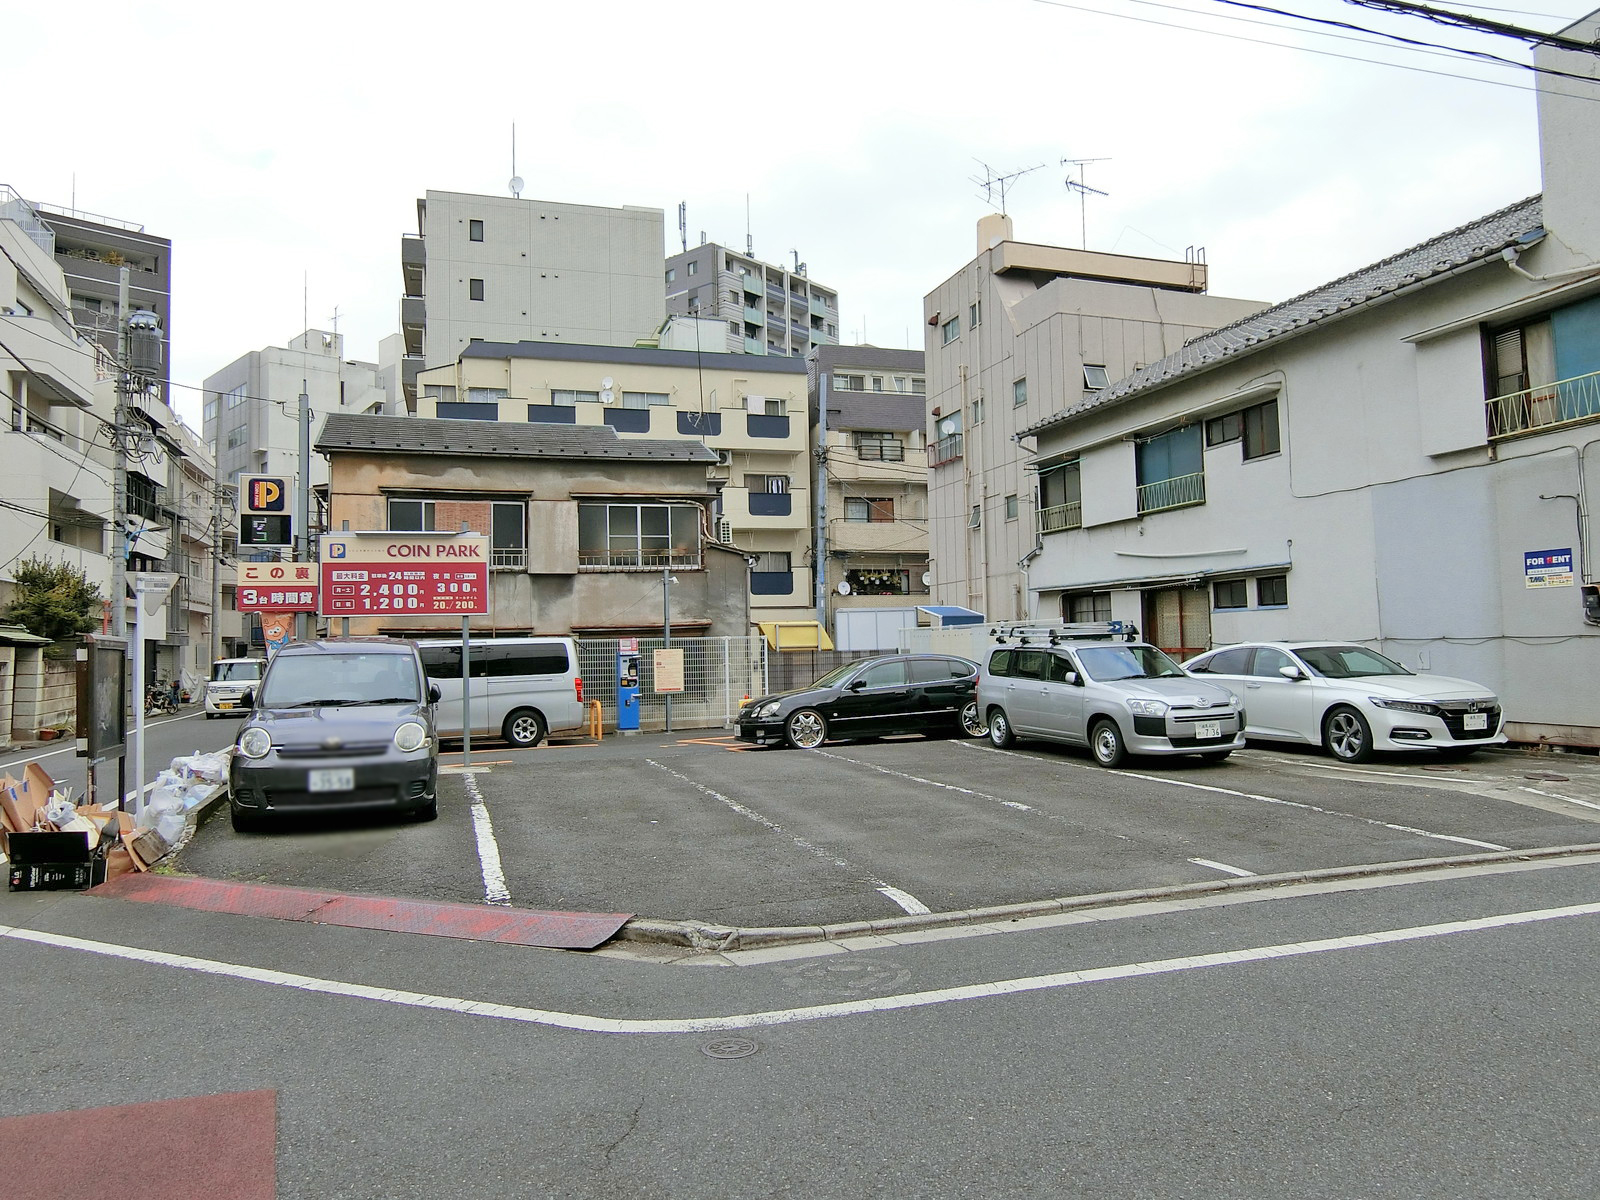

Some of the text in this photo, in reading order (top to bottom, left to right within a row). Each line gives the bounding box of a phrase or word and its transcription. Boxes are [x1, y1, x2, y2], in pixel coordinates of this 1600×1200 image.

[259, 481, 280, 508] P
[387, 544, 480, 557] COIN PARK
[1527, 555, 1570, 566] FOR RENT
[245, 567, 309, 579] この裏
[388, 571, 402, 580] 24
[13, 871, 20, 879] LG
